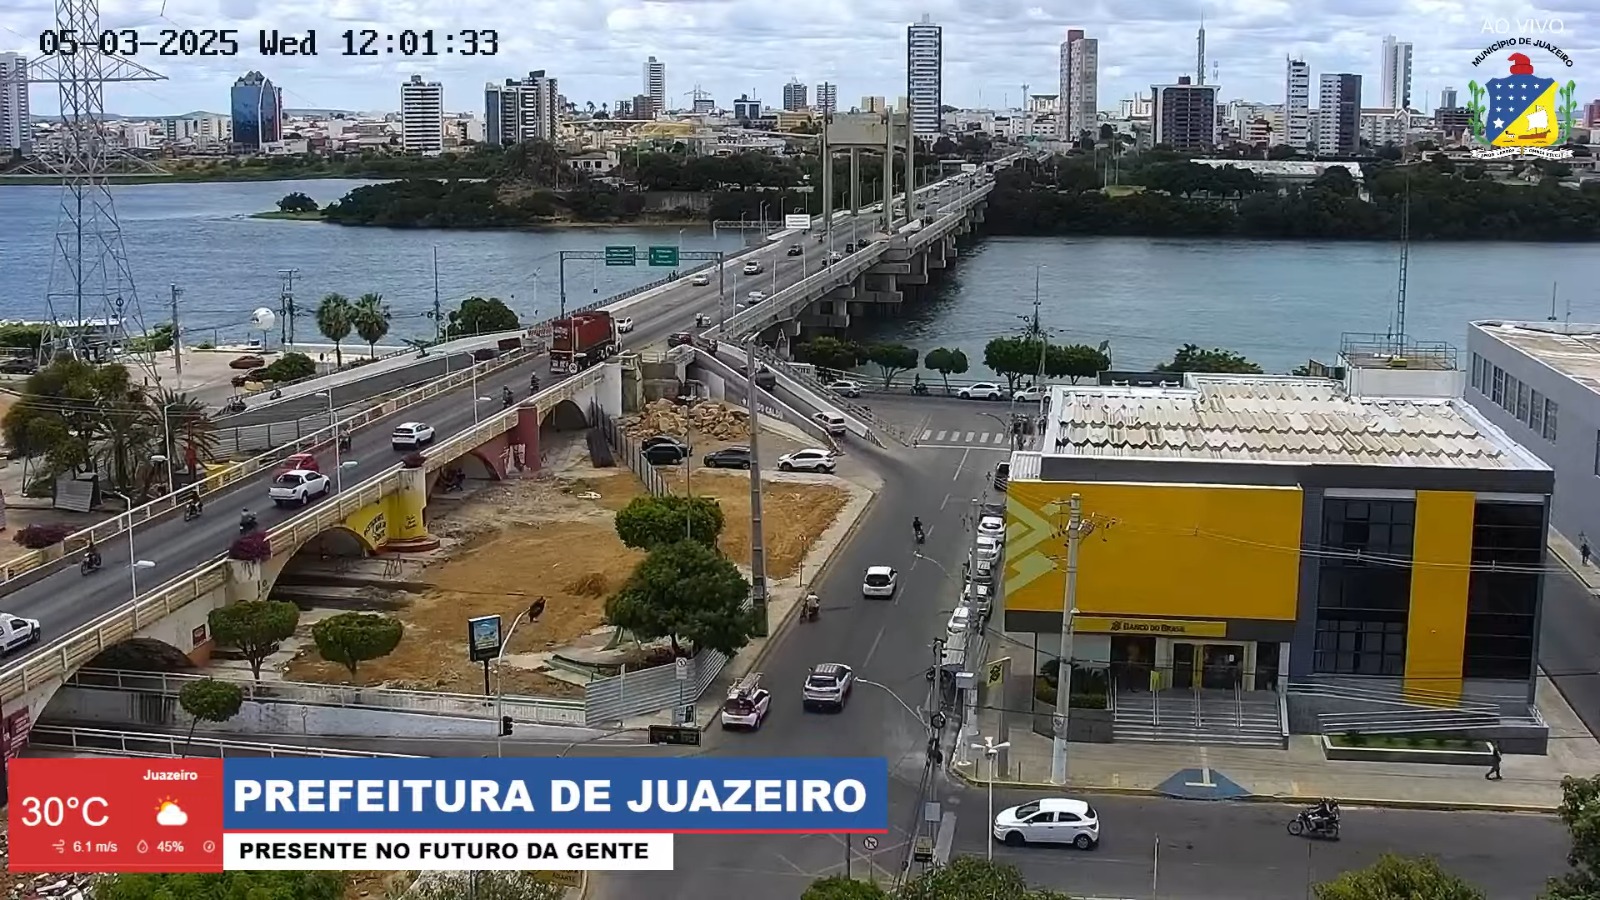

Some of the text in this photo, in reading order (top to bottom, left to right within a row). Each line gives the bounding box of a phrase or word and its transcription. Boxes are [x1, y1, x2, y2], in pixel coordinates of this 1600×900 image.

[1123, 622, 1185, 633] BANCO DO BRASIL
